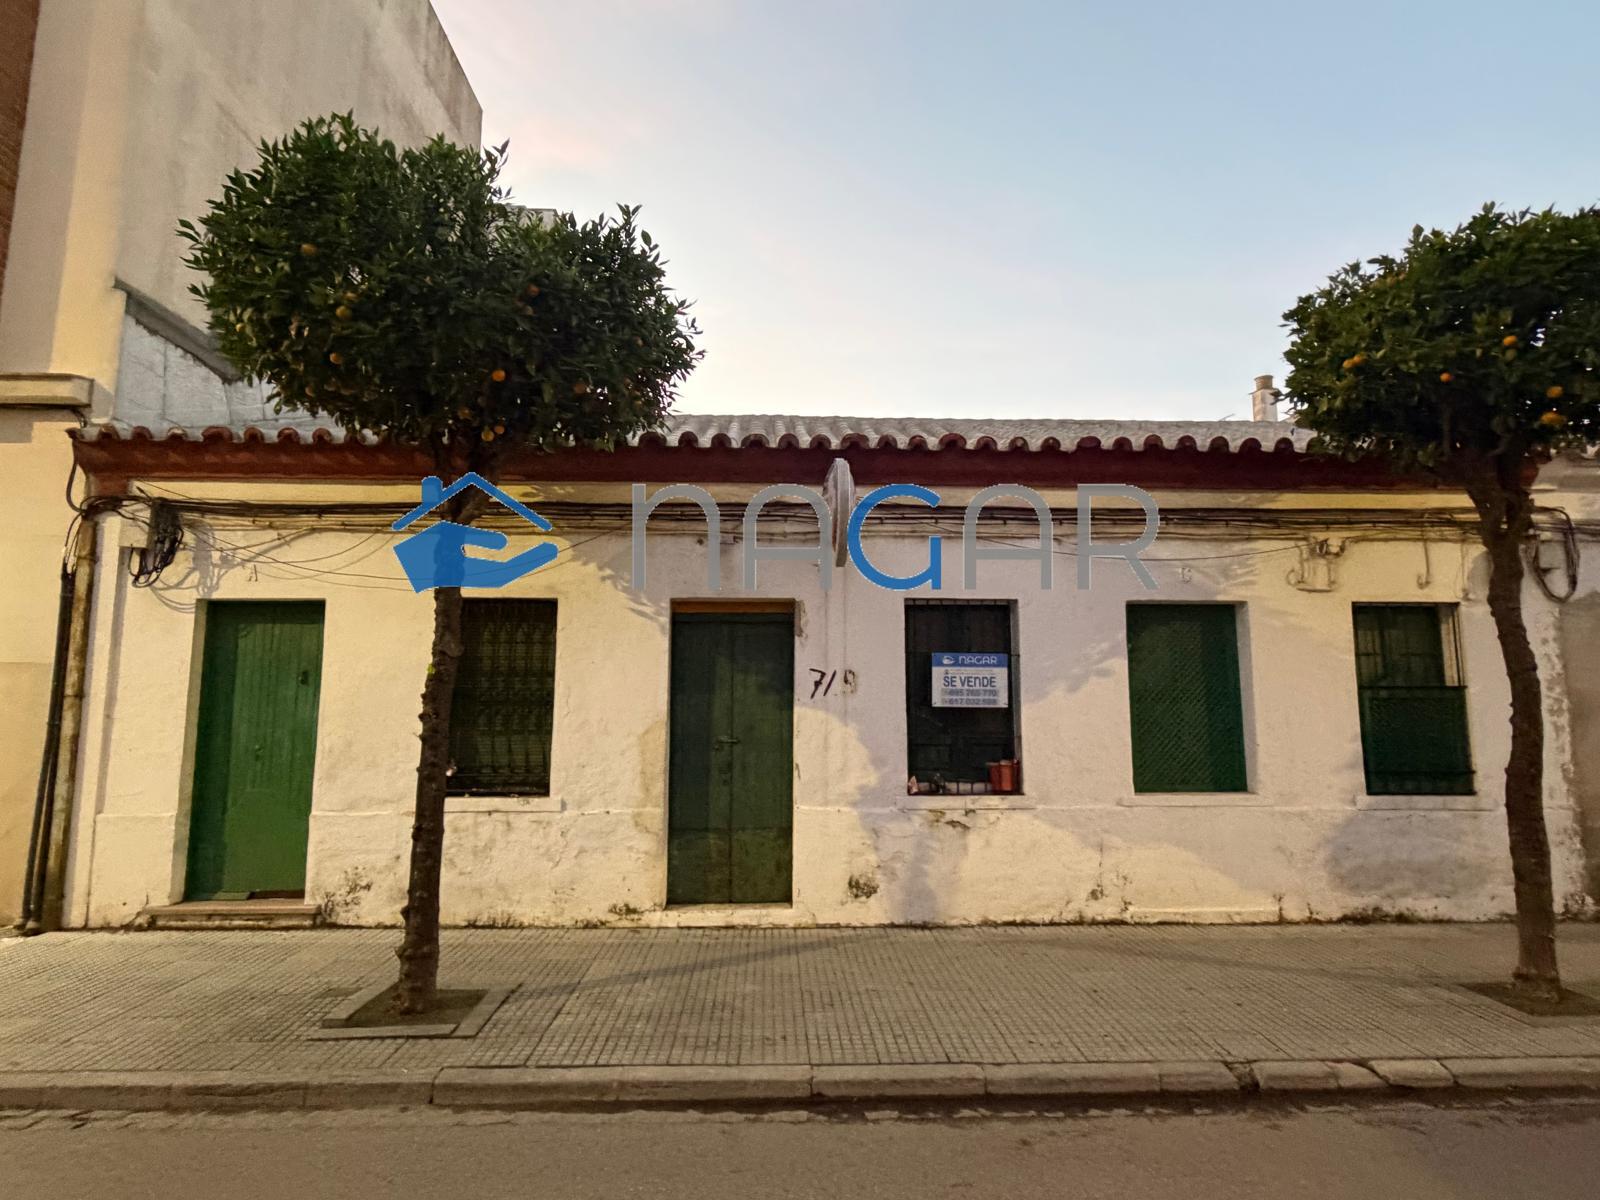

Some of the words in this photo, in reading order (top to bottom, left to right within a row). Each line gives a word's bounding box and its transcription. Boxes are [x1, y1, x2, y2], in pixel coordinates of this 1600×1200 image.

[958, 655, 998, 665] NAGAR
[943, 675, 957, 687] SE
[960, 675, 997, 688] VENDE
